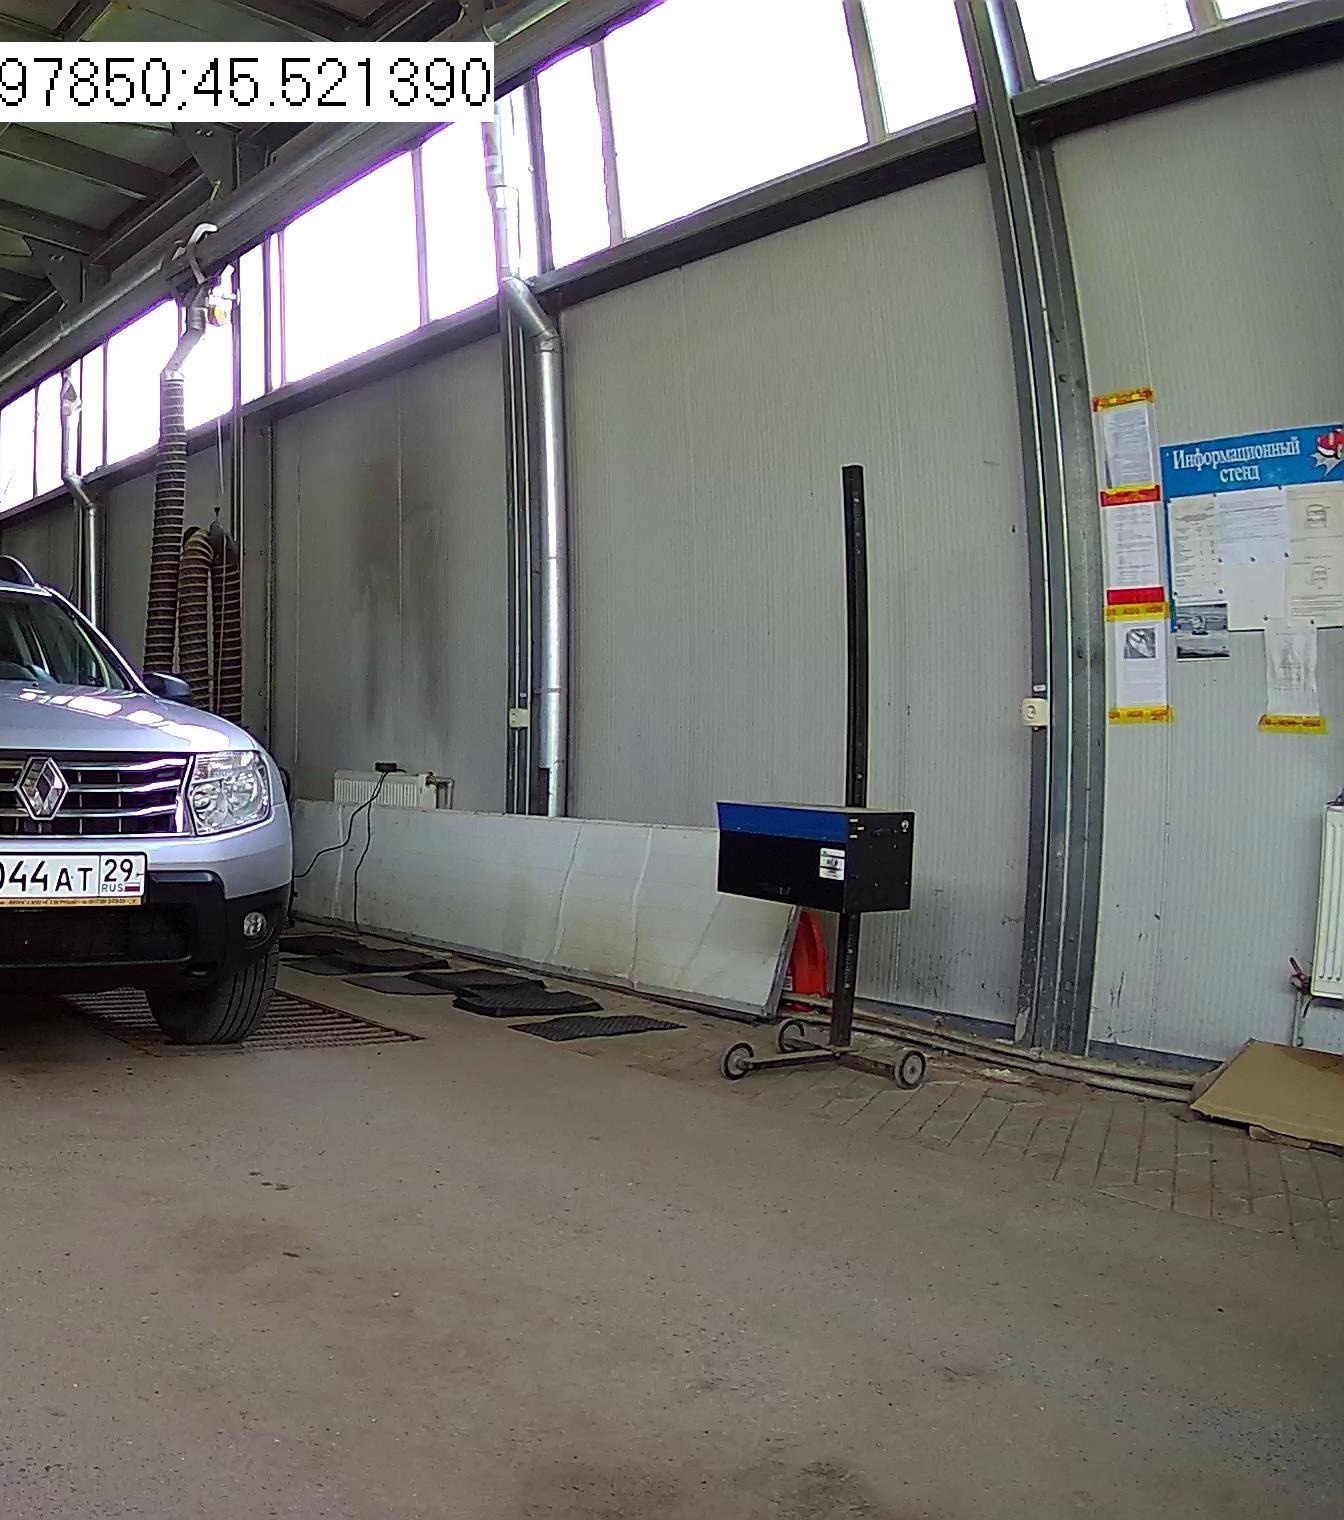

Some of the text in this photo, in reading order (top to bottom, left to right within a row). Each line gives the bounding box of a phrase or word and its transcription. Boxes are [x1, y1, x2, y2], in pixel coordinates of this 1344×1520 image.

[1172, 436, 1301, 472] Информационный
[1219, 464, 1261, 483] стенд
[101, 883, 124, 893] RUS
